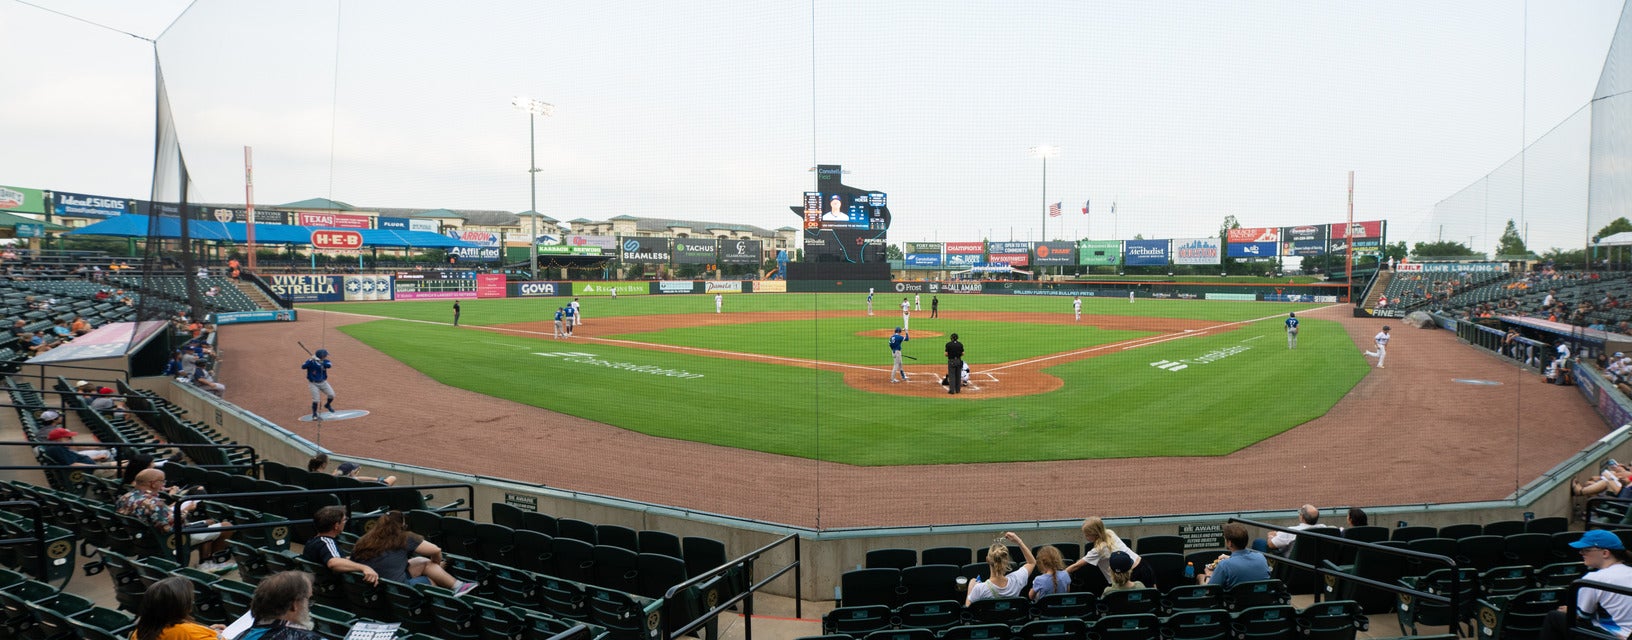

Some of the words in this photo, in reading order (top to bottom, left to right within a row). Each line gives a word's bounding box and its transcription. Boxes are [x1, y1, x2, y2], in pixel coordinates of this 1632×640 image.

[303, 215, 333, 225] TEXAS
[461, 232, 490, 241] ARROW
[685, 245, 715, 253] TACHUS
[1128, 247, 1164, 256] Methodist
[623, 252, 668, 261] SEAMLESS
[310, 276, 327, 285] TU
[521, 283, 555, 294] GOYA
[905, 282, 922, 292] Frost
[1372, 309, 1395, 317] FINE
